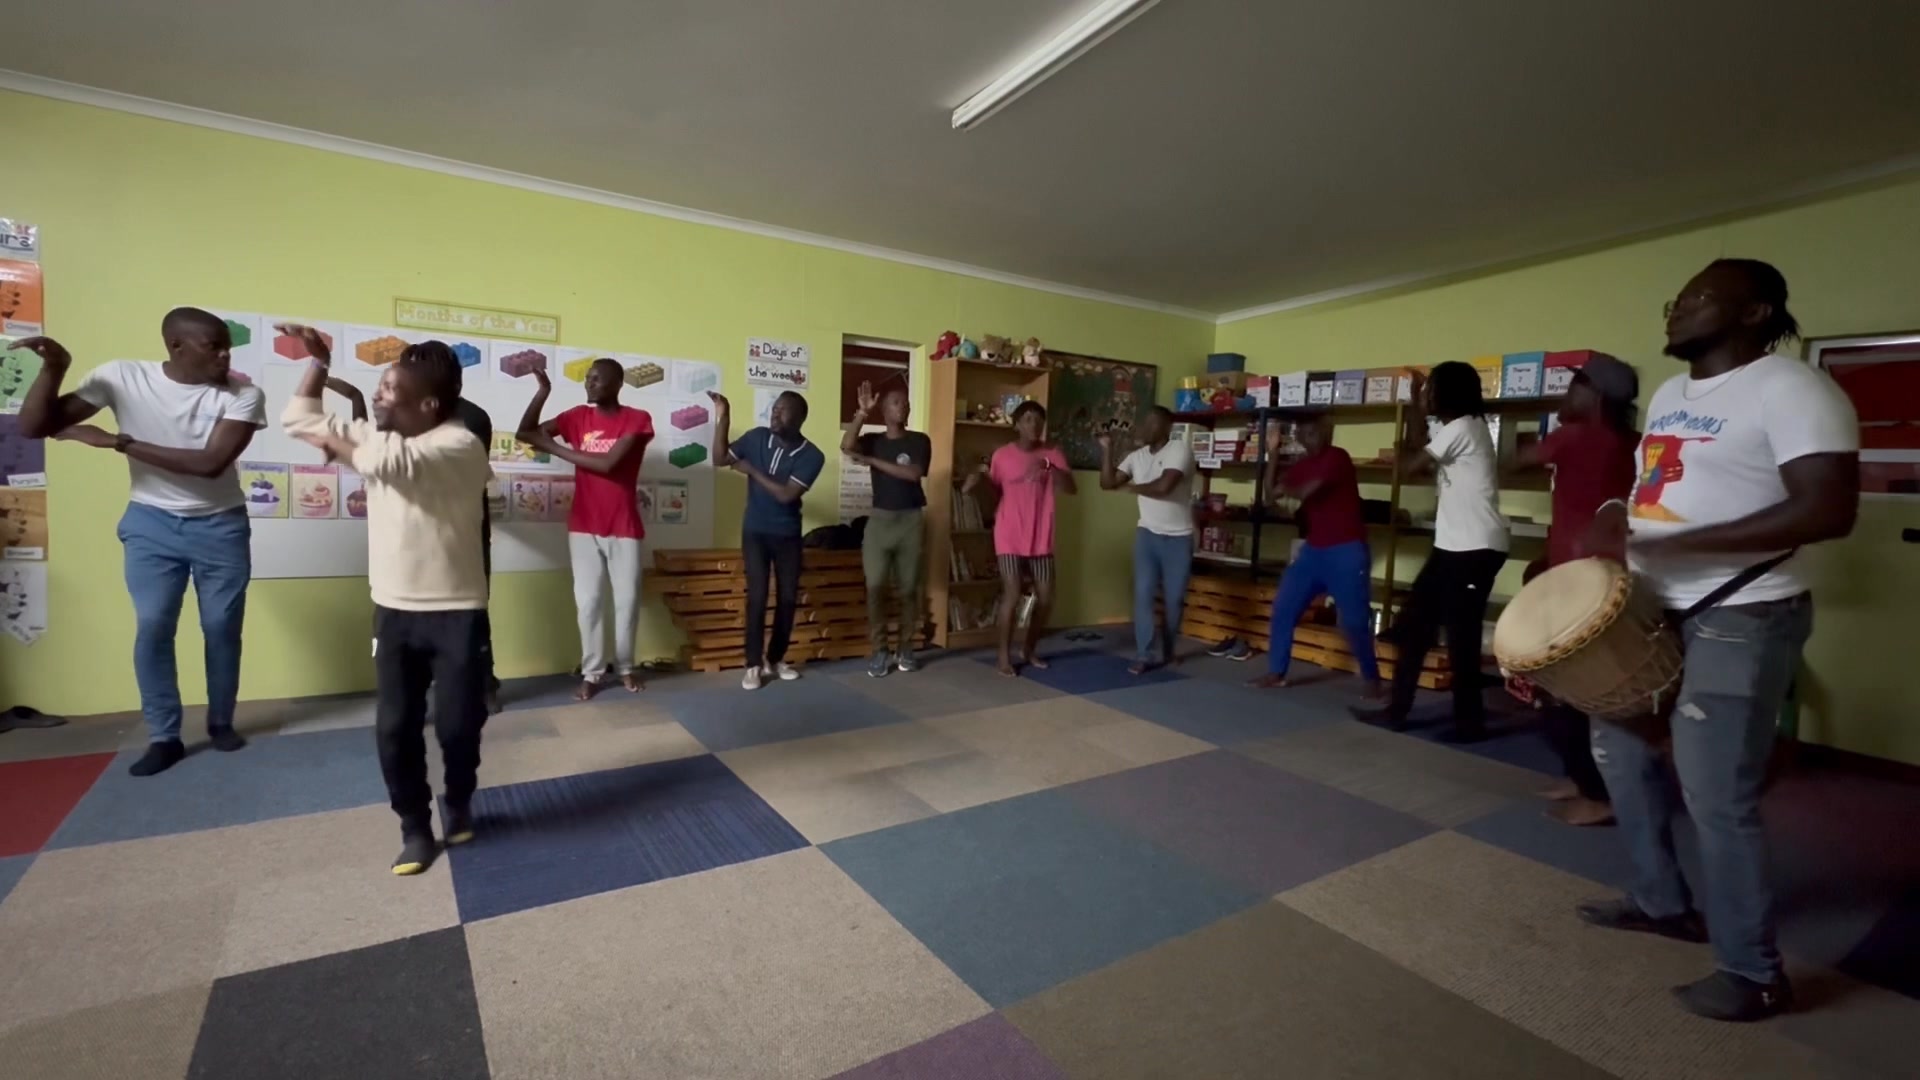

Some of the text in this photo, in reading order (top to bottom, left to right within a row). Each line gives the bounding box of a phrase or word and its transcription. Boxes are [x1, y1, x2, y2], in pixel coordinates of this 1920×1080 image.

[399, 303, 555, 334] Months of the Year
[762, 342, 803, 361] Days of
[749, 365, 768, 377] the
